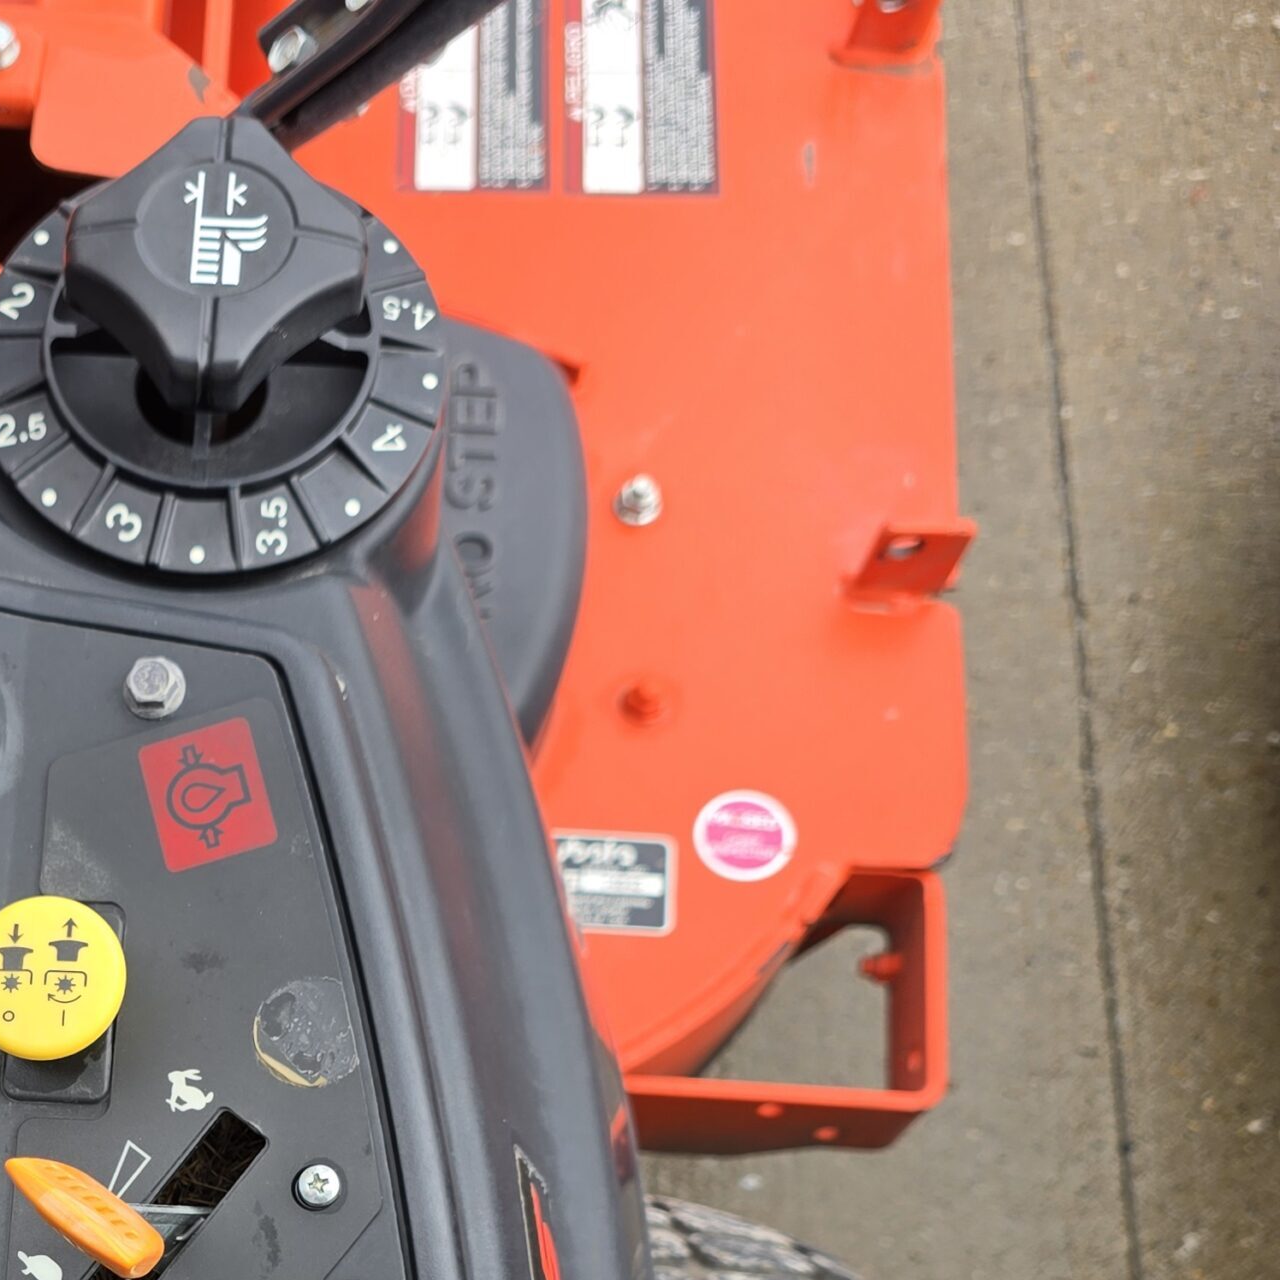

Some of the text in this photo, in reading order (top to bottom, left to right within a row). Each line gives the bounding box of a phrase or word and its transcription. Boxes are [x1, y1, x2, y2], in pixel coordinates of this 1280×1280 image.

[382, 295, 436, 331] 4.5
[372, 423, 407, 452] 4
[445, 362, 500, 513] STEP
[105, 503, 142, 542] 3
[255, 496, 288, 556] 3.5
